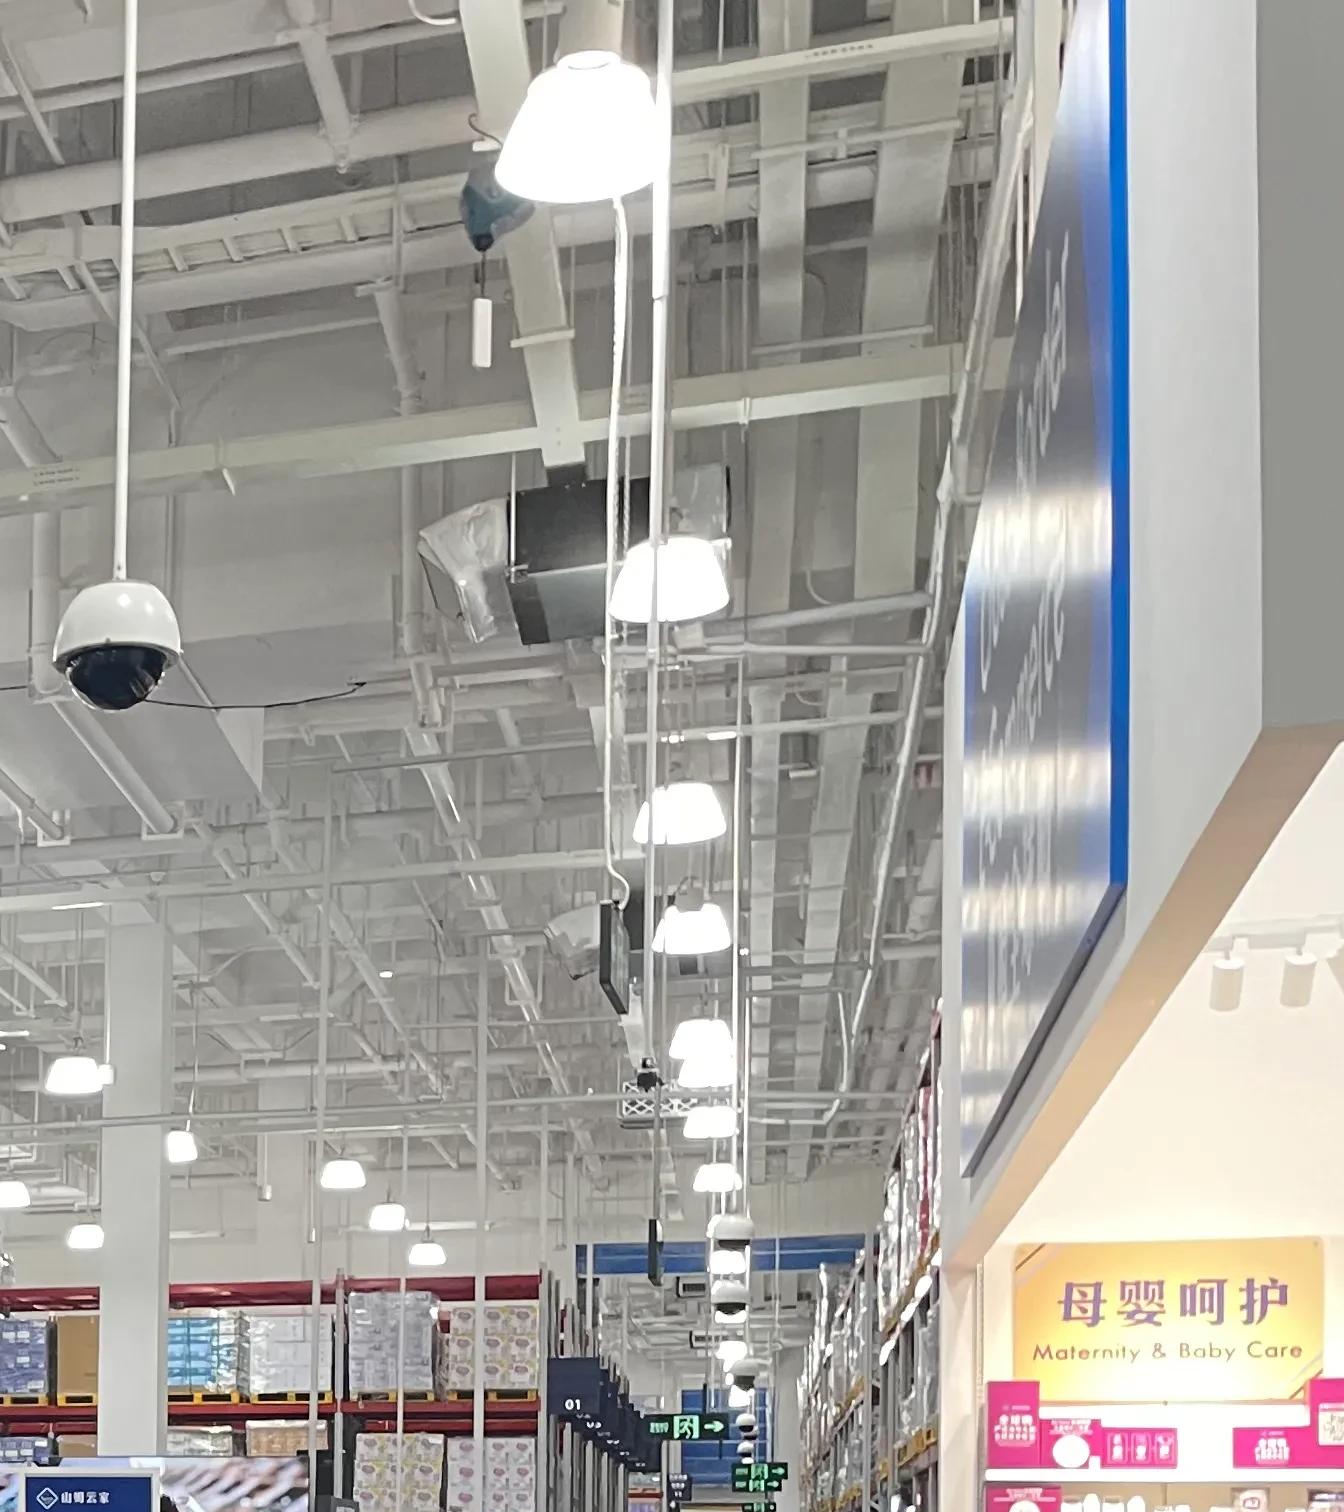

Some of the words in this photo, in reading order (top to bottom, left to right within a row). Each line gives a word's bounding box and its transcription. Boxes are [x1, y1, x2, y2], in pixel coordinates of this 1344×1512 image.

[1057, 1277, 1289, 1328] 母婴呵护
[1032, 1343, 1140, 1363] Maternity
[1152, 1342, 1167, 1359] &
[1179, 1342, 1236, 1362] Baby
[1247, 1340, 1303, 1359] Care
[564, 1398, 581, 1411] 01
